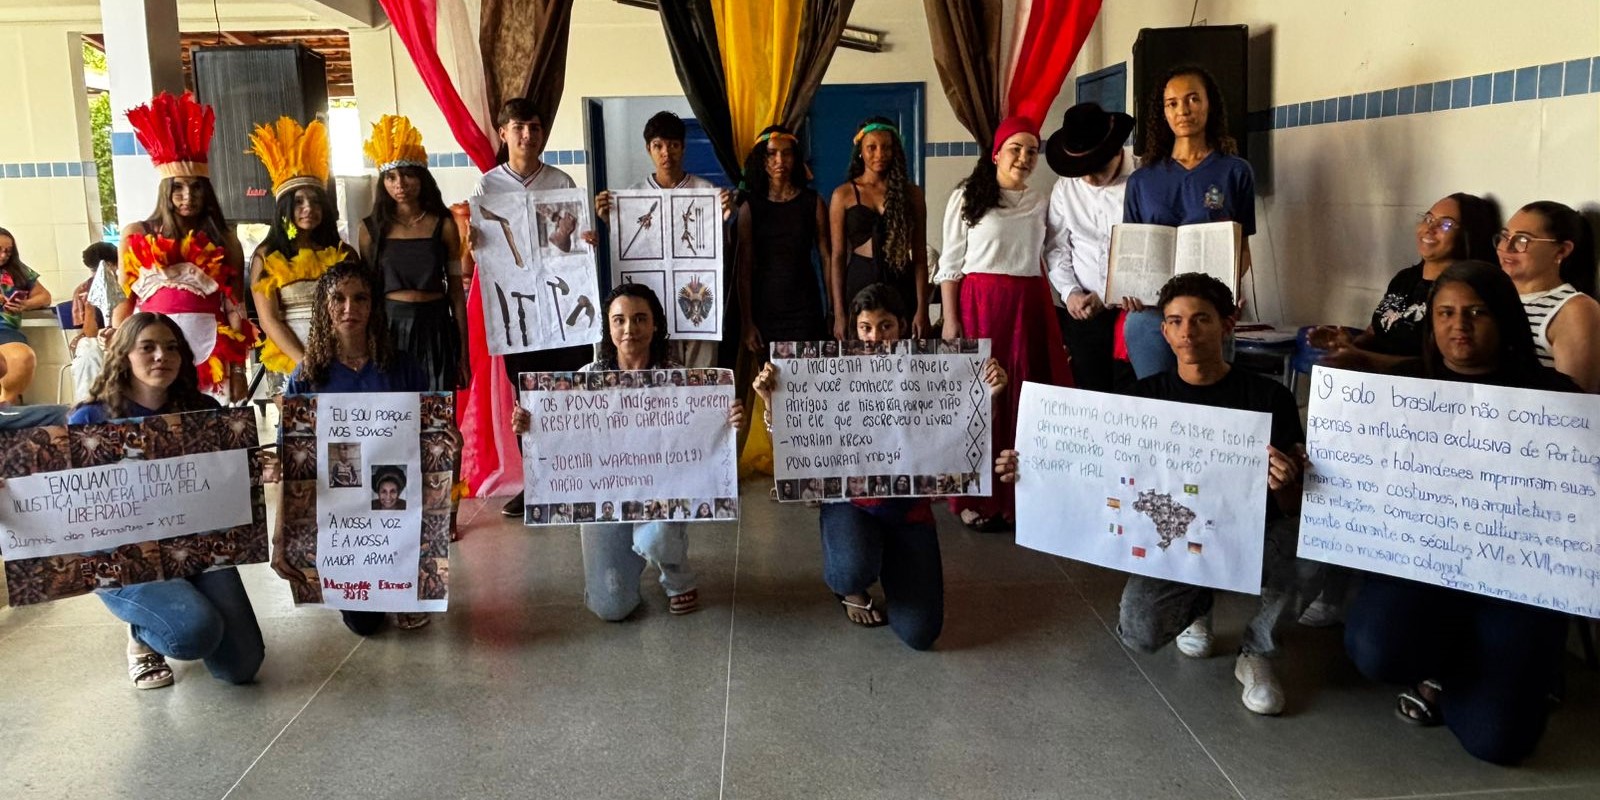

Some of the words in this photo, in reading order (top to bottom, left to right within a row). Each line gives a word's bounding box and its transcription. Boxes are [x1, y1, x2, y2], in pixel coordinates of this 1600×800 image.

[1342, 382, 1375, 404] solo
[1392, 386, 1466, 414] brasileiro
[1471, 402, 1499, 419] não
[1508, 405, 1589, 429] conheceu
[351, 409, 372, 421] SOU
[376, 409, 413, 421] PORQUE
[1444, 429, 1511, 454] exclusiva
[1520, 440, 1539, 458] de
[138, 461, 197, 484] HOUVER
[143, 483, 172, 498] LUTA
[178, 478, 210, 493] PELA
[158, 514, 186, 526] XVII
[340, 517, 372, 529] NOSSA
[381, 518, 402, 529] VOZ
[1568, 513, 1576, 522] e
[1464, 522, 1471, 531] e
[342, 535, 350, 547] A
[353, 534, 389, 546] NOSSA
[322, 555, 355, 566] MAIOR
